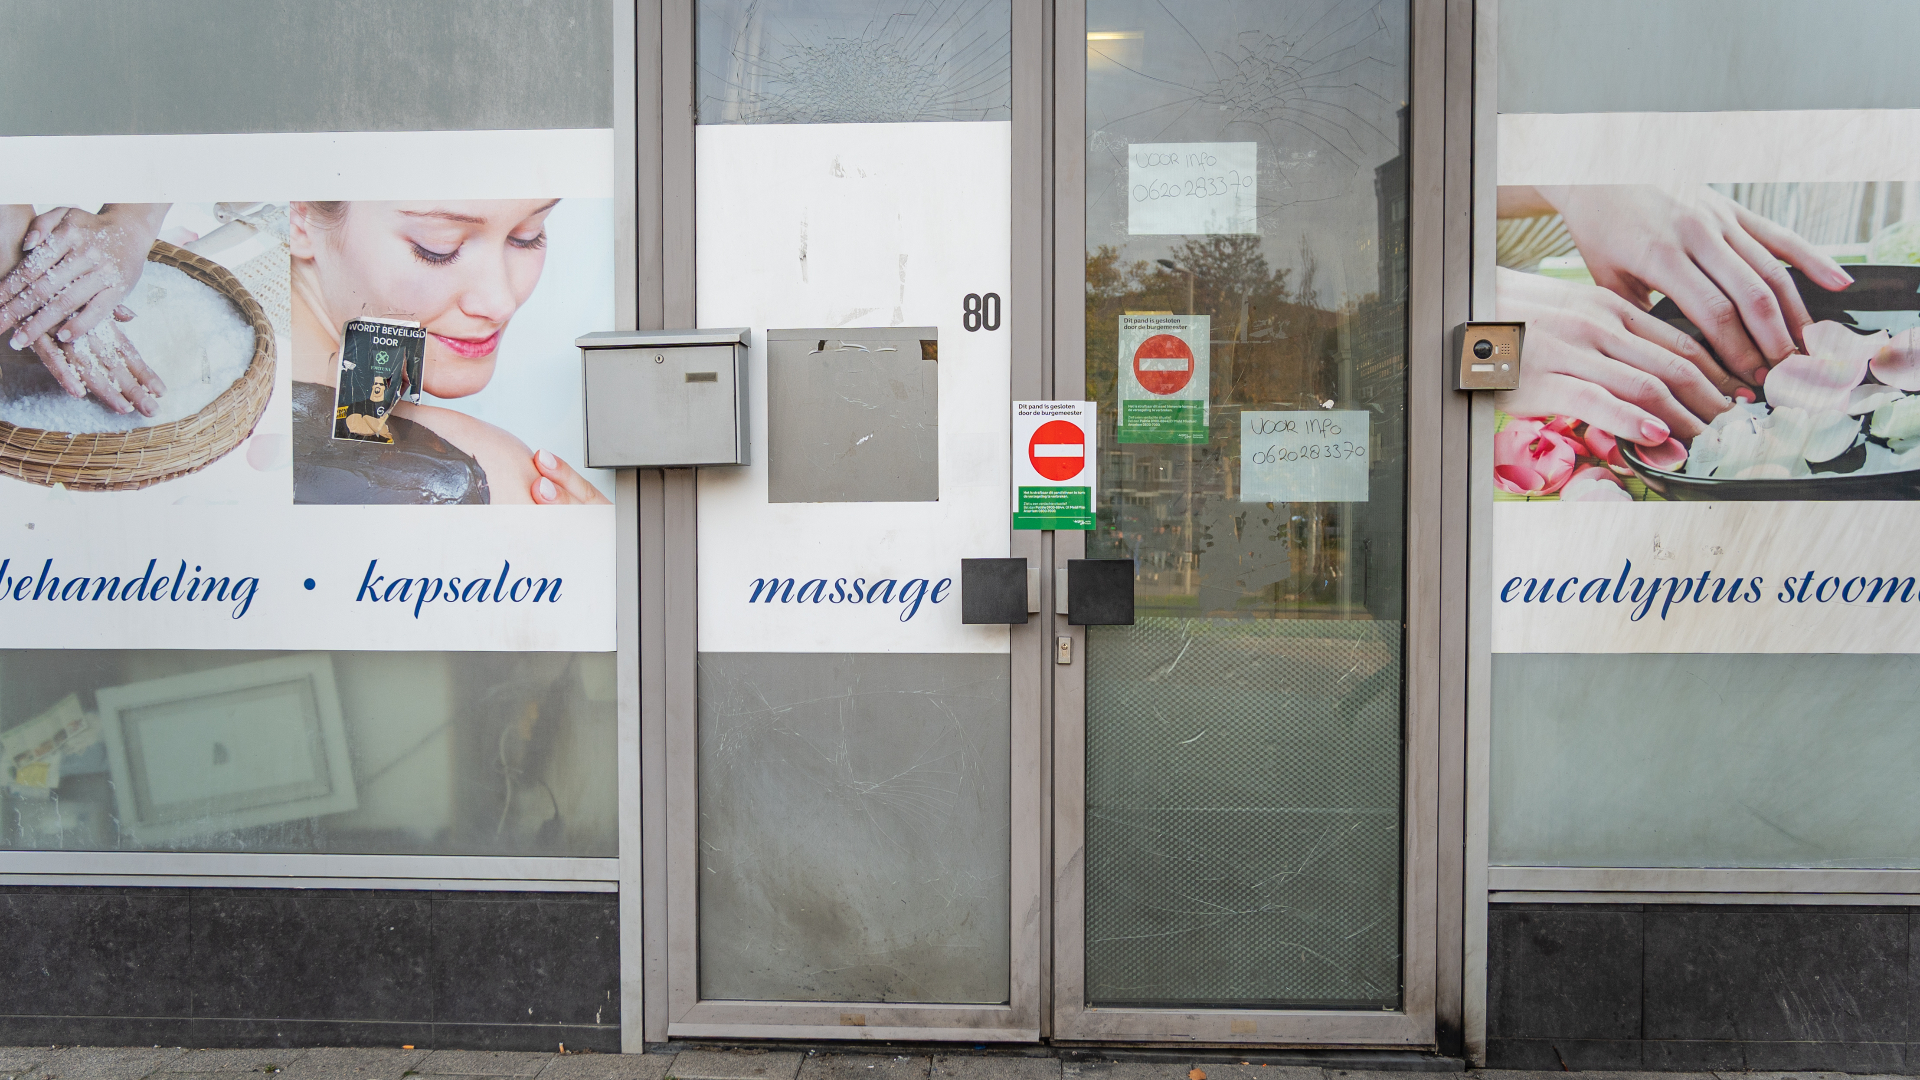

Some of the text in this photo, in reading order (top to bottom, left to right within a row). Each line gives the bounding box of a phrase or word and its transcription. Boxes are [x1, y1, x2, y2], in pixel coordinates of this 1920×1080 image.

[964, 293, 1001, 332] 80
[1133, 317, 1149, 325] pand
[1155, 317, 1181, 325] gesloten
[349, 323, 426, 338] WORDT BEVEILIGD
[373, 337, 399, 347] DOOR
[1028, 403, 1044, 411] pand
[1050, 403, 1076, 411] gesloten
[355, 559, 564, 620] kapsalon
[748, 577, 952, 622] massage
[1501, 558, 1920, 621] eucalyptus stoom
